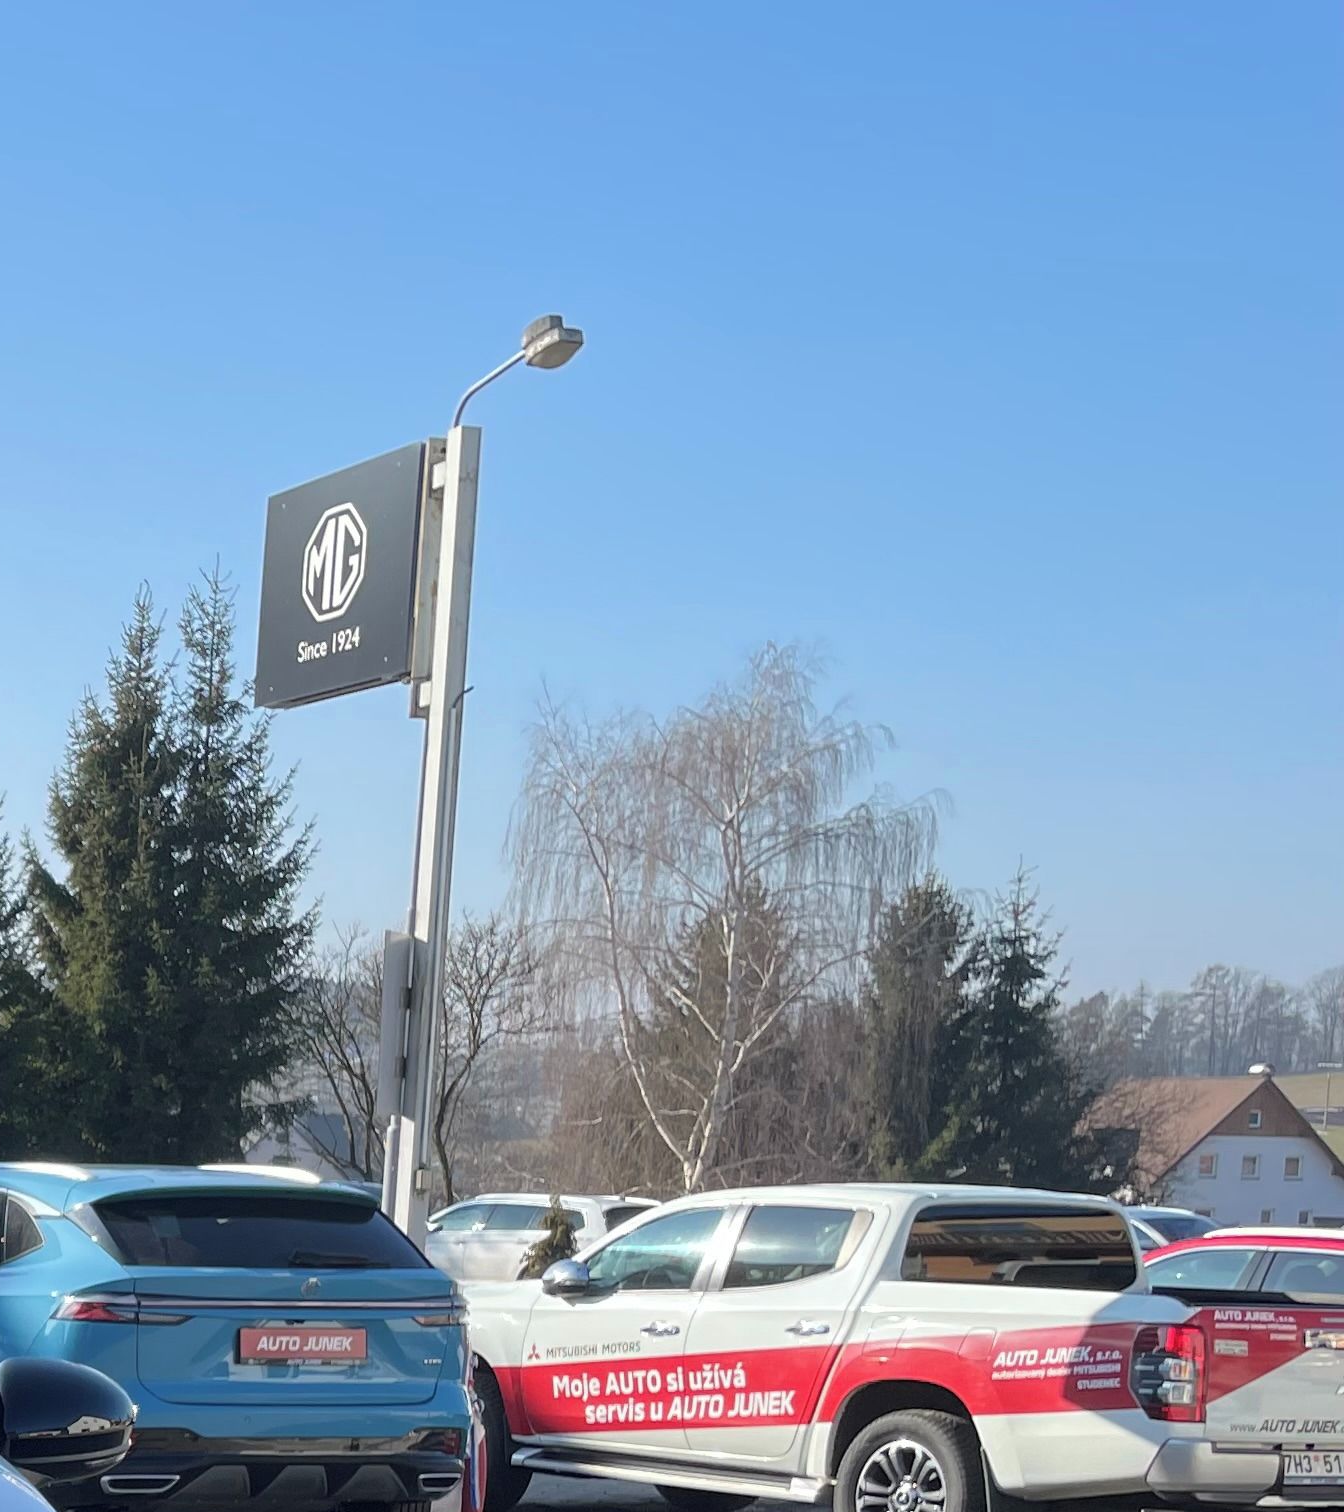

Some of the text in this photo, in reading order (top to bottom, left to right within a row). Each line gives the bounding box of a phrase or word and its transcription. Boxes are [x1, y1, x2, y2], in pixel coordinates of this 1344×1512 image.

[307, 513, 362, 611] MG
[296, 625, 361, 664] Since 1924
[1214, 1309, 1242, 1321] AUTO
[256, 1335, 353, 1352] AUTO JUNEK
[545, 1341, 641, 1359] MITSUBISHI MOTORS
[992, 1350, 1038, 1368] AUTO
[552, 1361, 747, 1402] Moje AUTO si užívá
[584, 1390, 796, 1424] servis u AUTO JUNEK
[1283, 1454, 1313, 1473] 7H3
